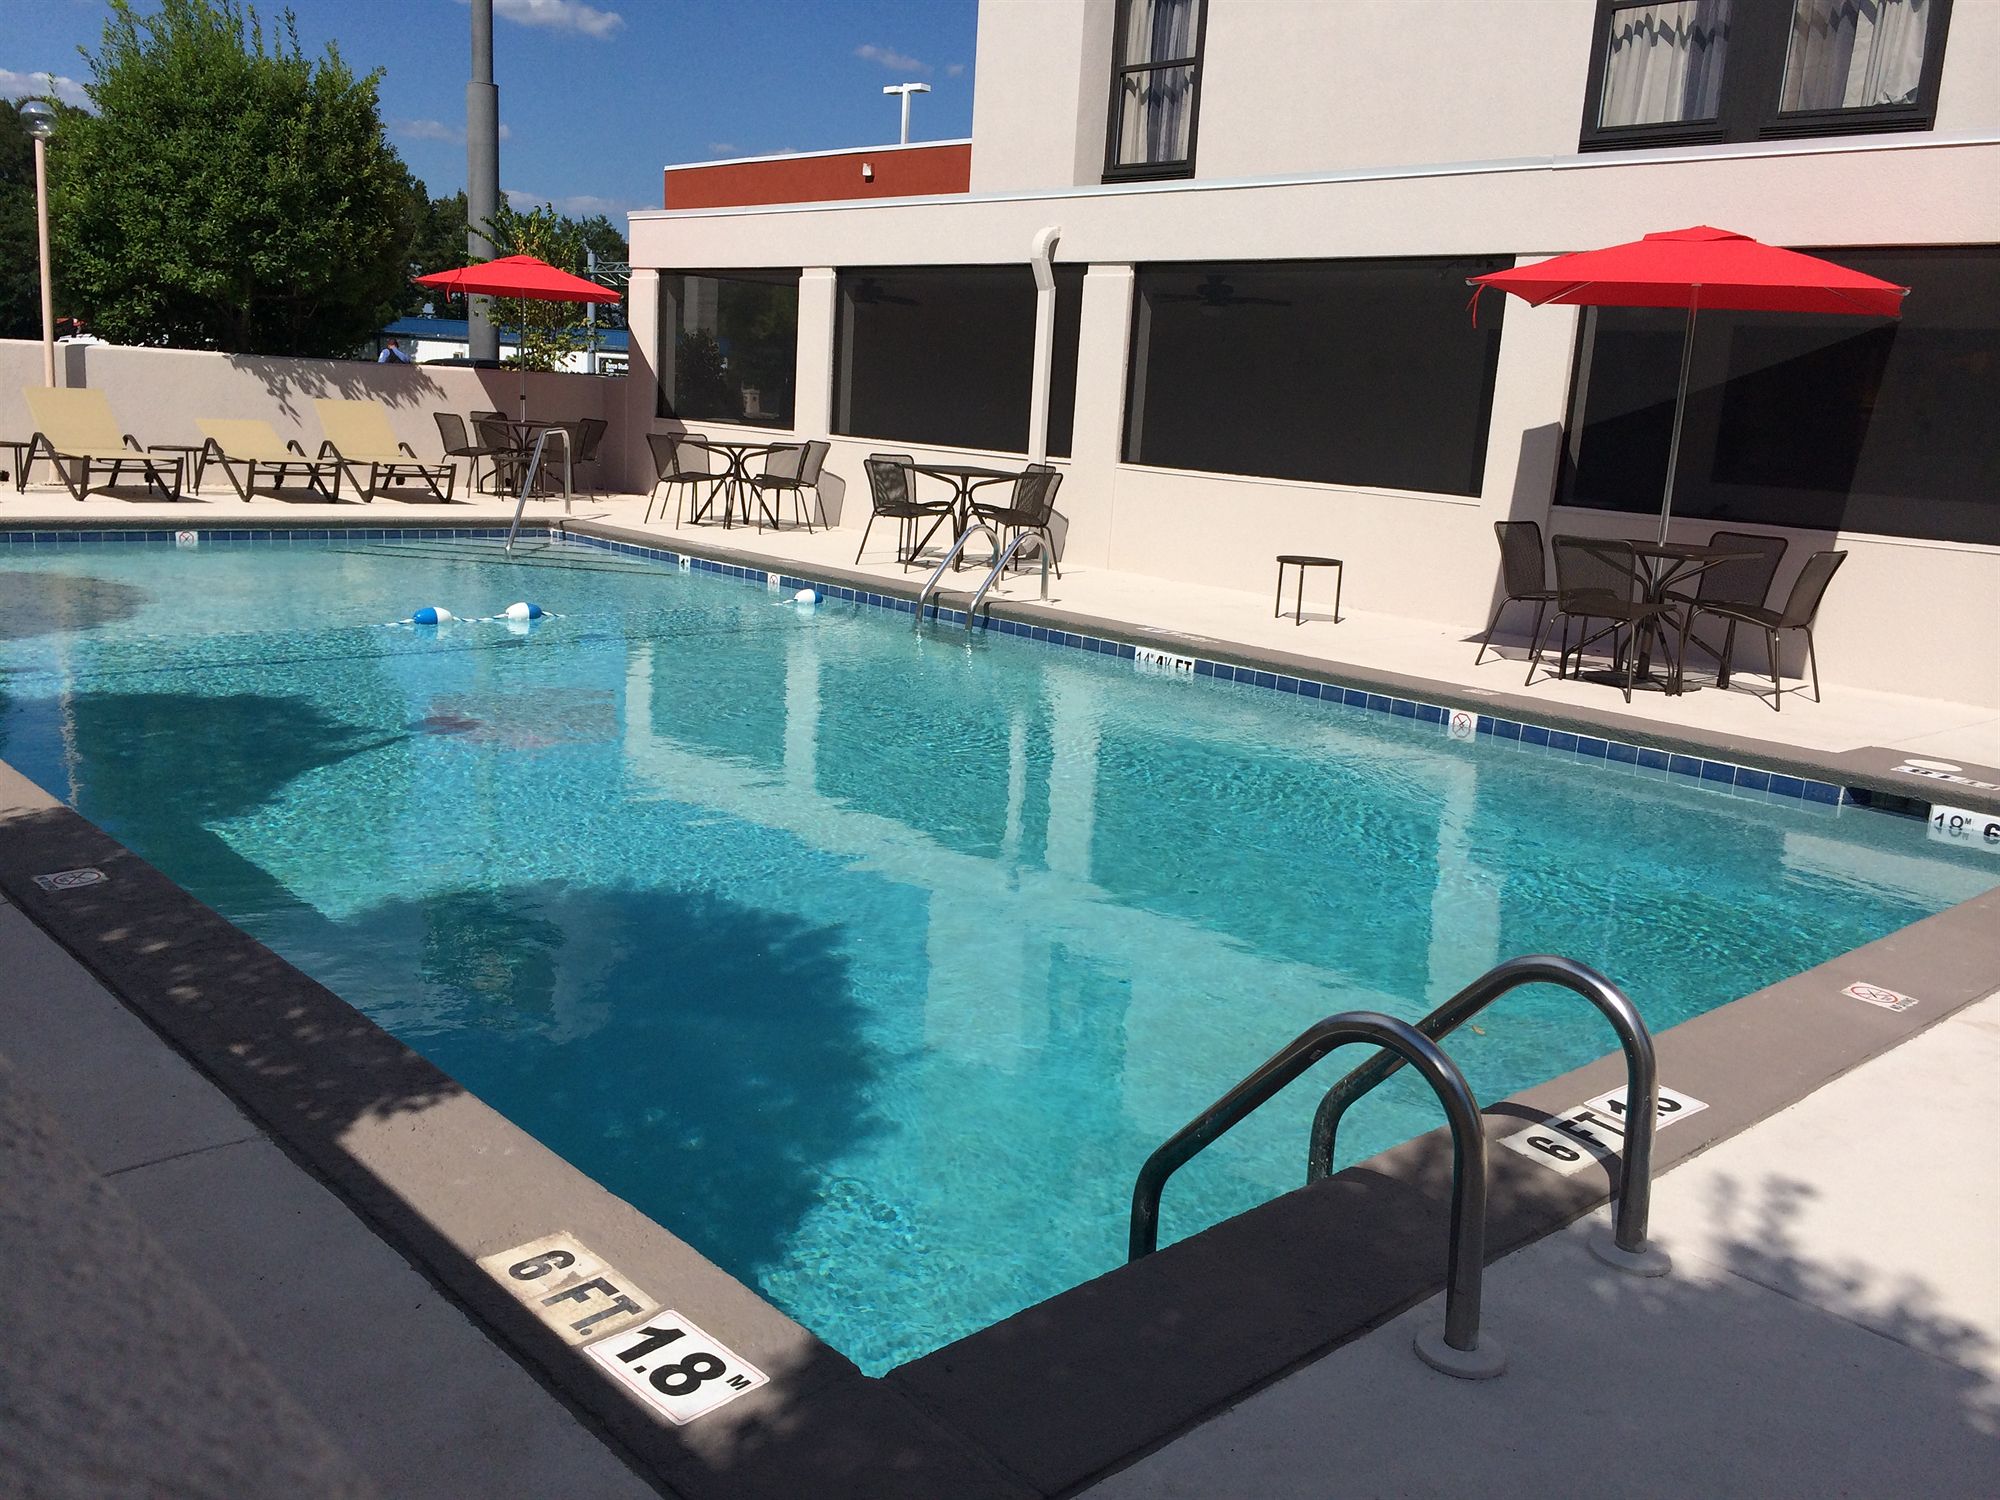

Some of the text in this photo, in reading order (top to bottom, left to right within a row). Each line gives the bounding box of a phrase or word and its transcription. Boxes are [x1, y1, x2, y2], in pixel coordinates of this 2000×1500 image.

[1526, 1136, 1580, 1162] 6
[1555, 1111, 1625, 1148] FT
[508, 1250, 576, 1281] 6
[615, 1326, 727, 1397] 1.8
[726, 1374, 752, 1391] M
